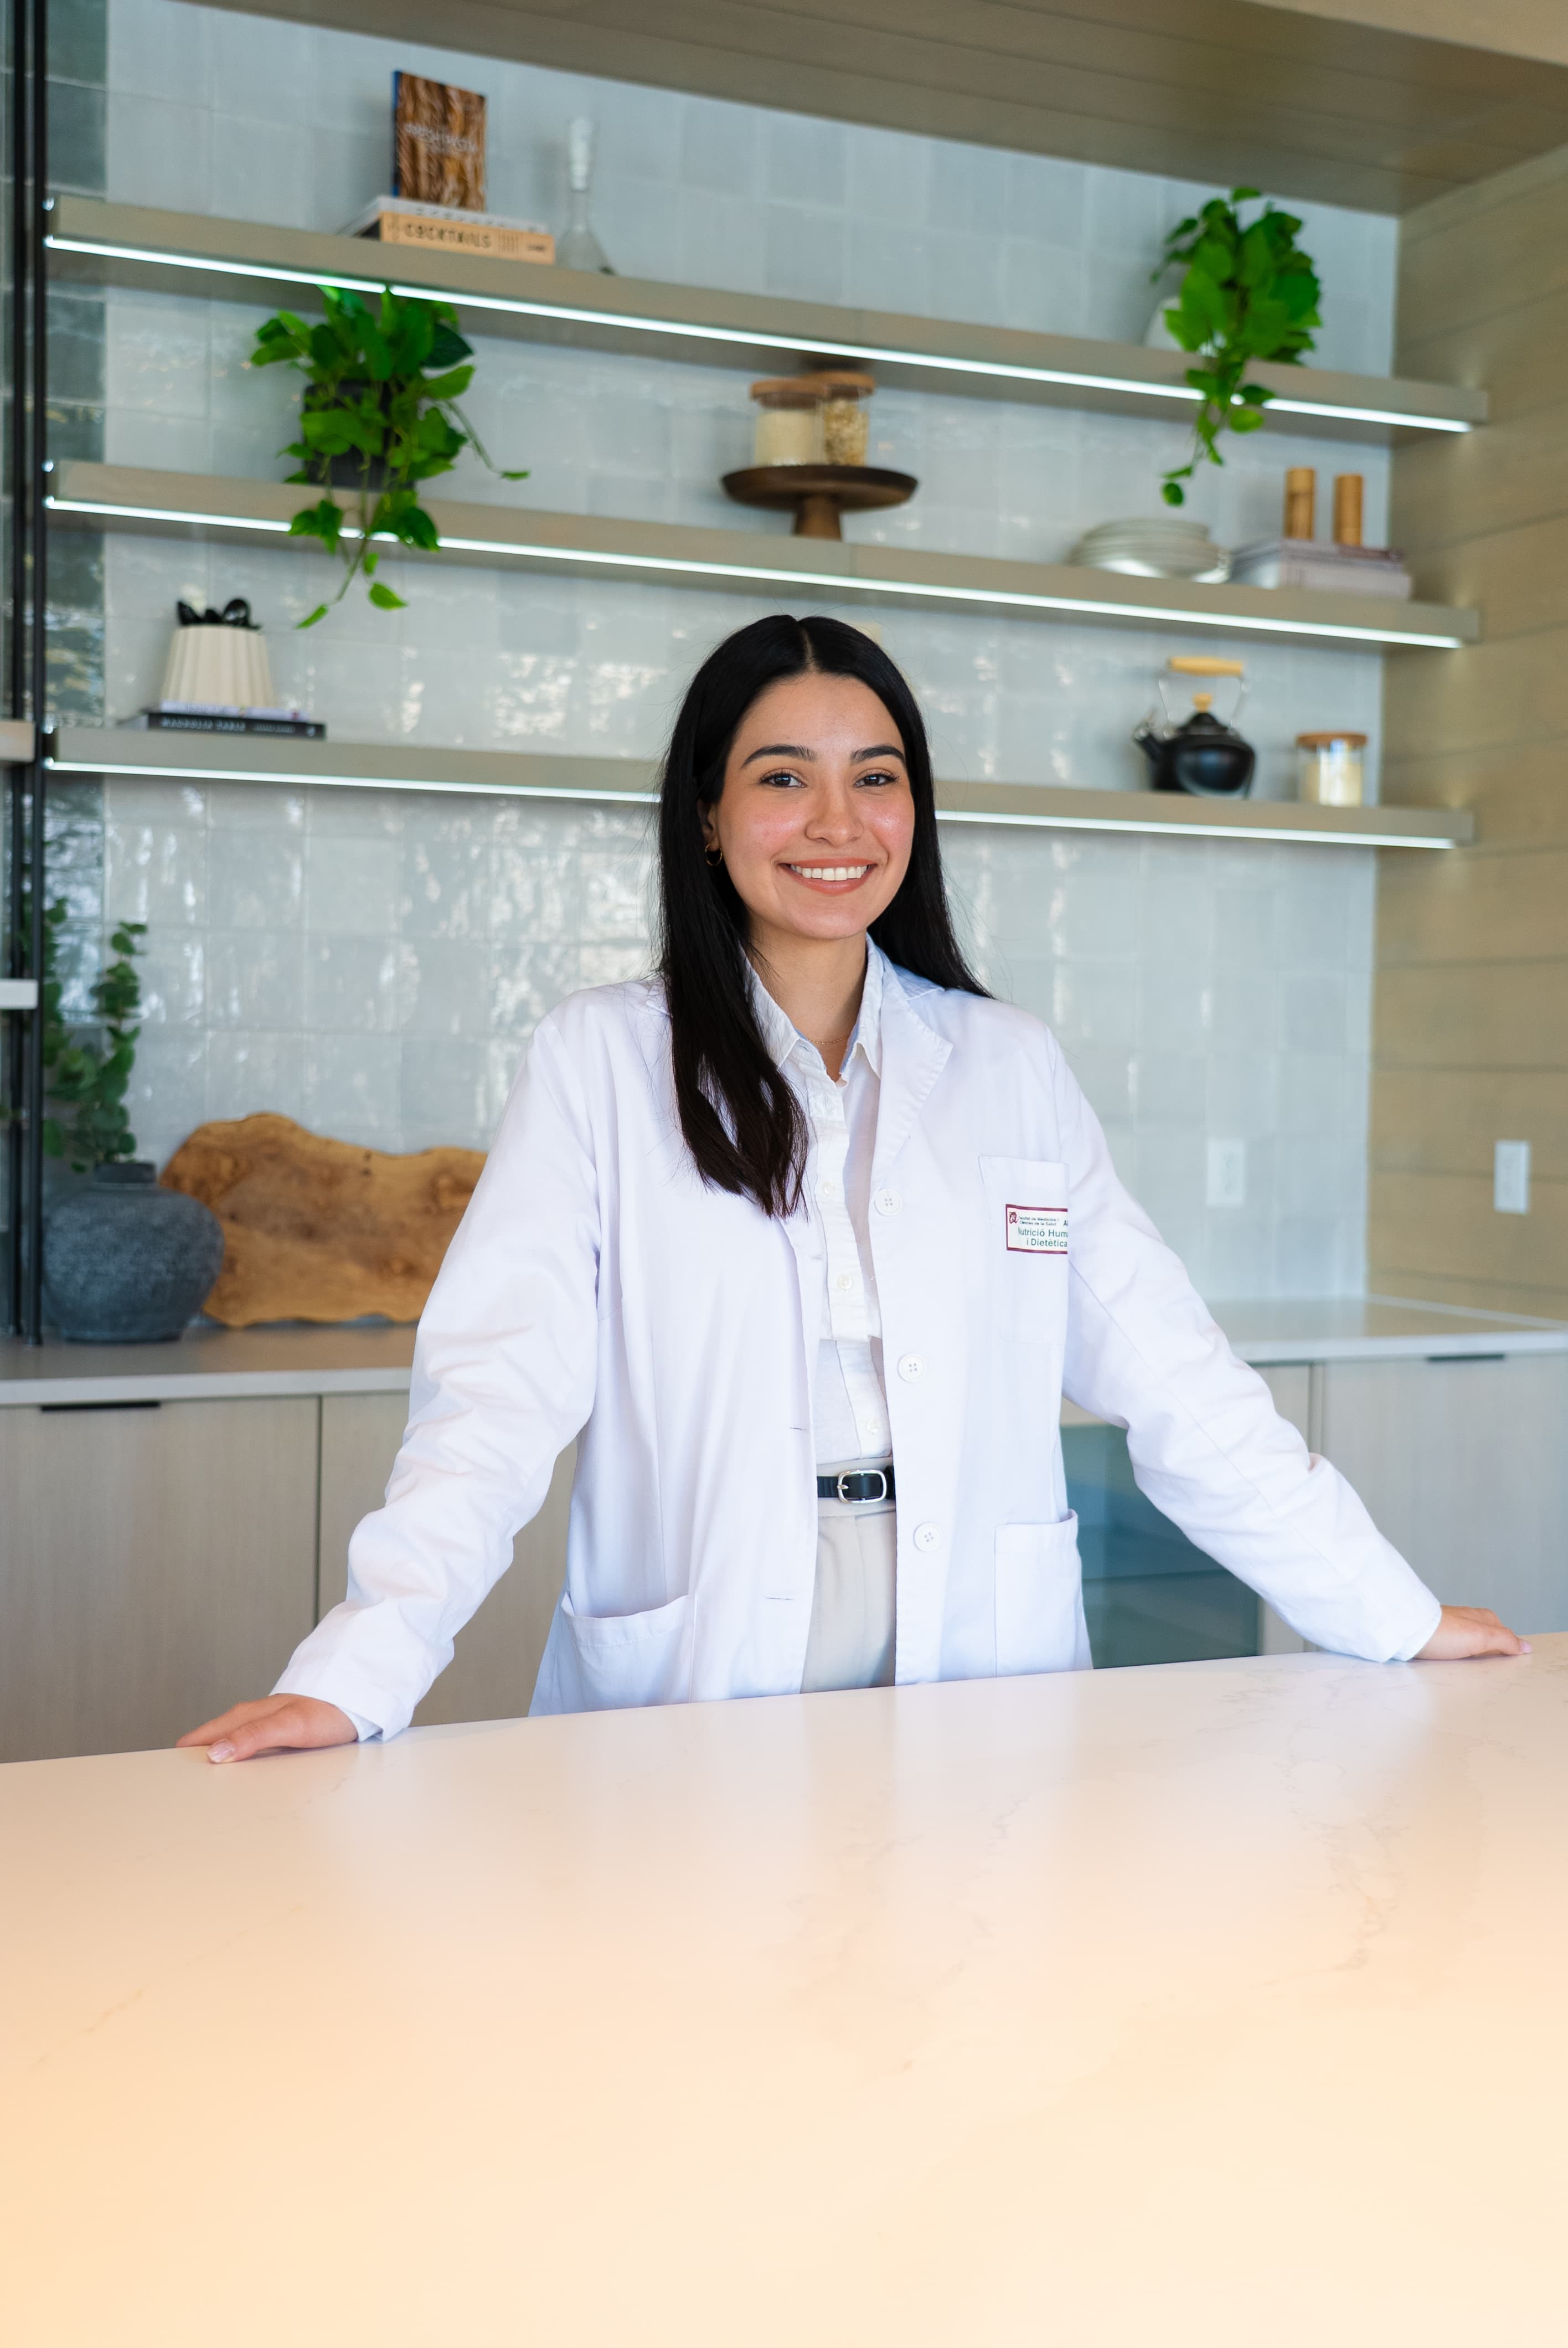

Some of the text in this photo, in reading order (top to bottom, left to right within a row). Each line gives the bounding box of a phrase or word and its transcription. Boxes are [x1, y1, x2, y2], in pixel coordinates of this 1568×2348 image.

[404, 223, 492, 249] COCKTAILS
[1018, 1227, 1045, 1237] Nutrició
[1031, 1238, 1067, 1247] Dietètica
